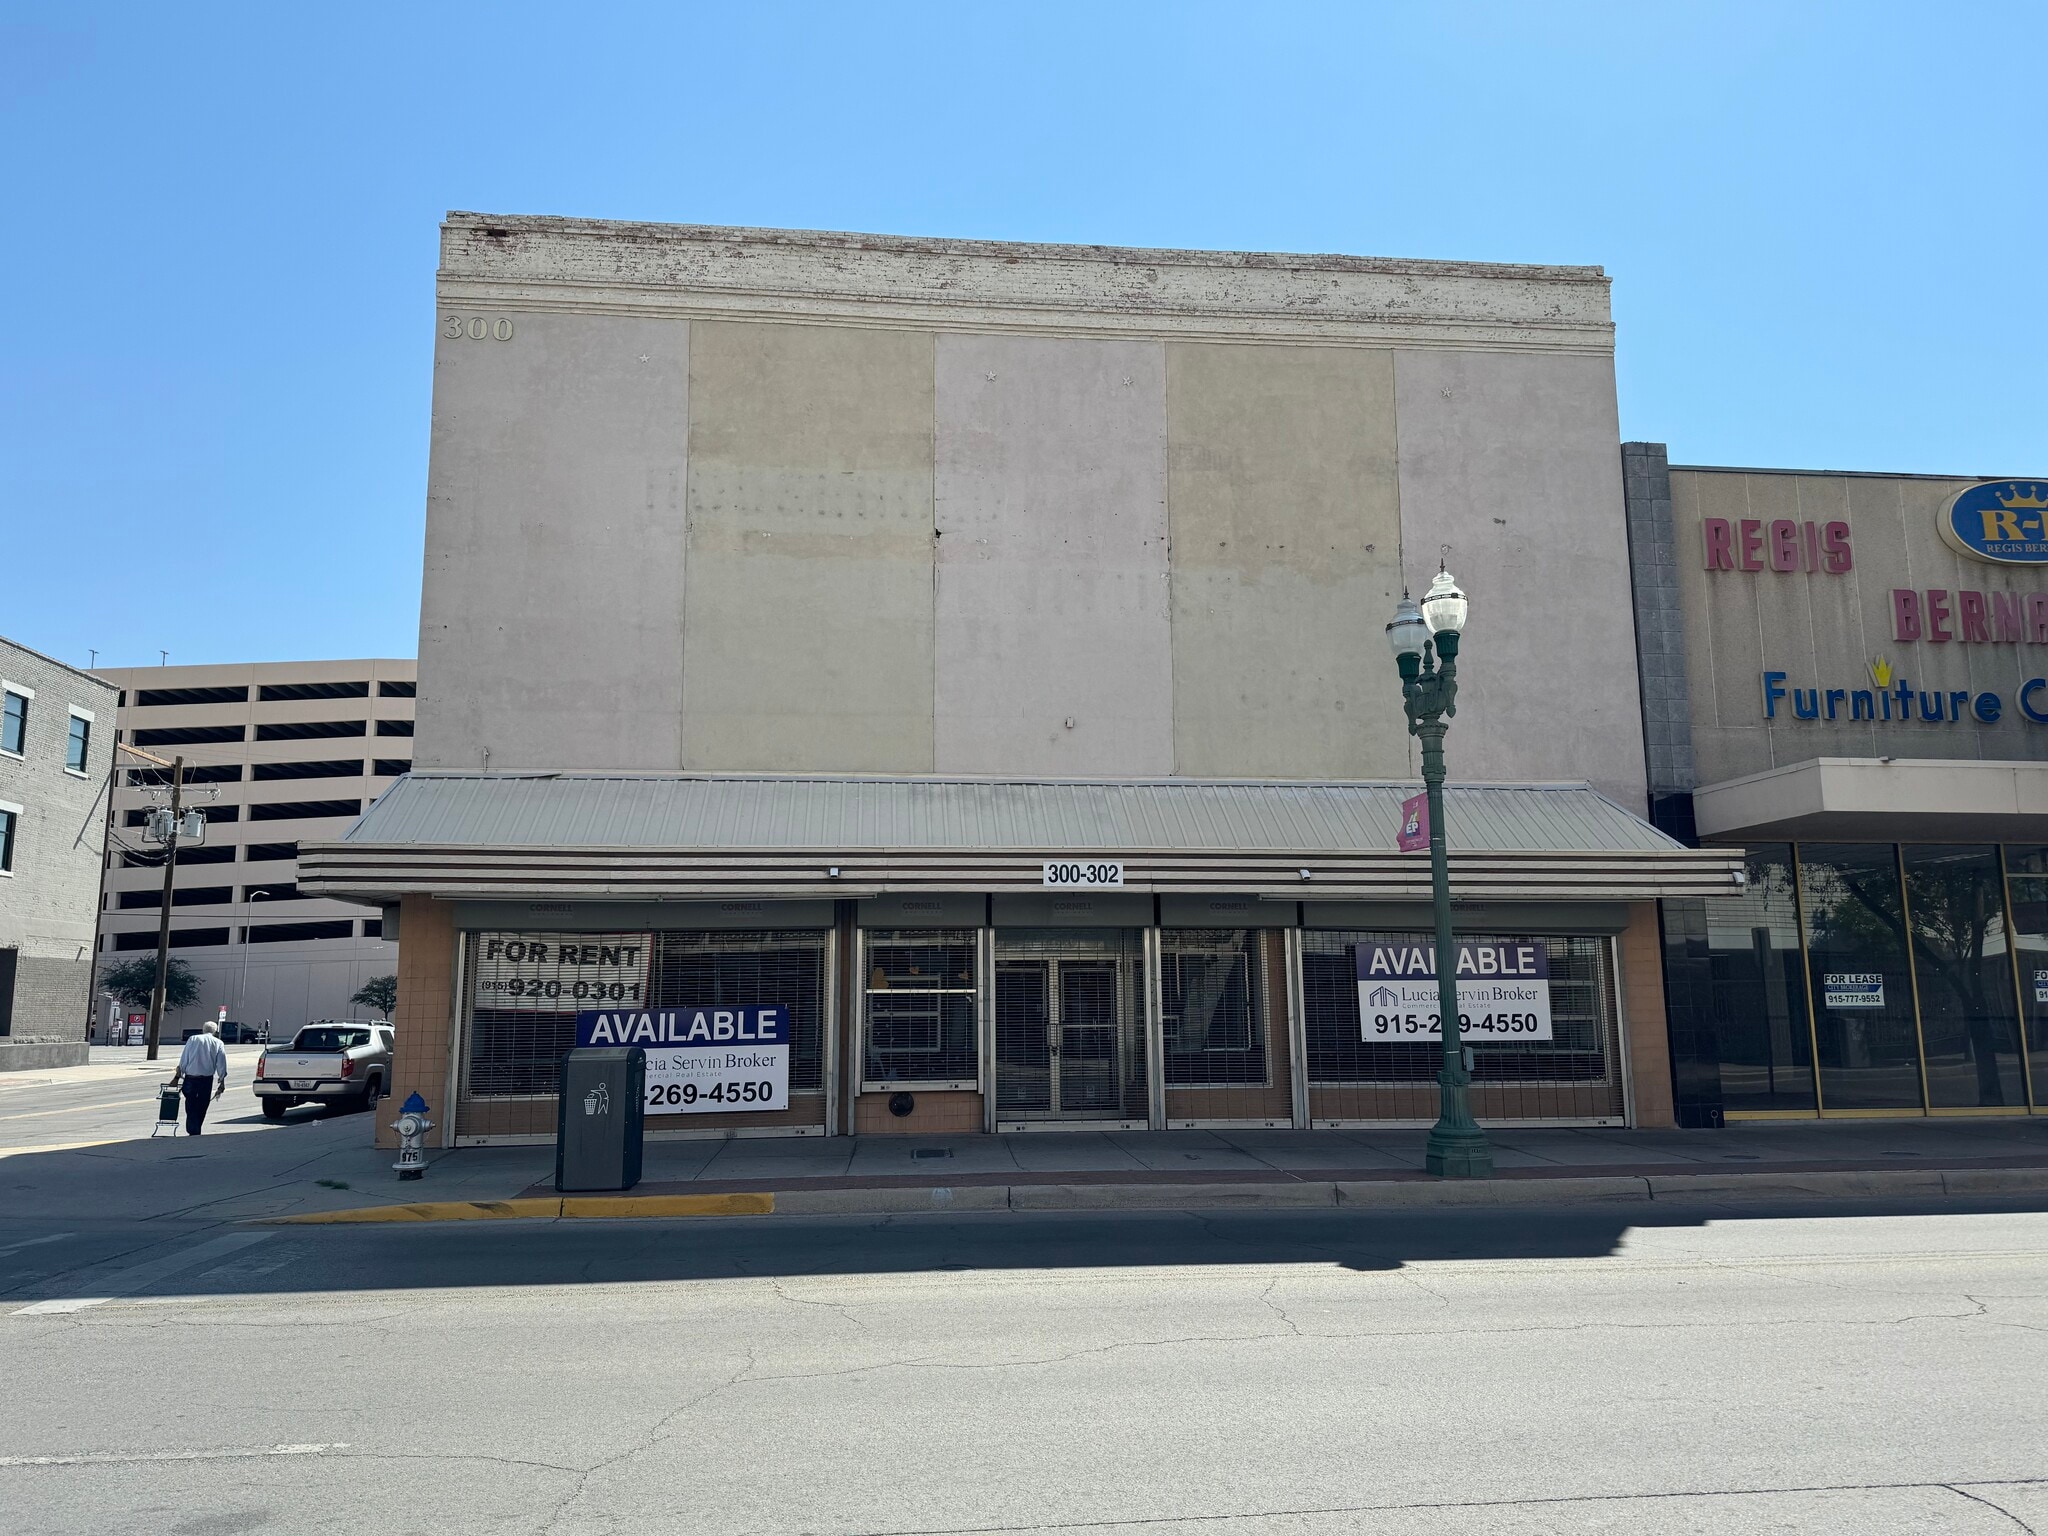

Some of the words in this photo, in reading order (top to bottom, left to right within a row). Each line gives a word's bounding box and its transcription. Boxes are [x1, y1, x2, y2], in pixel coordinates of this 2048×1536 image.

[443, 315, 514, 341] 300
[1977, 510, 2048, 541] R-
[1704, 518, 1853, 574] REGIS
[1986, 543, 2023, 553] REGIS
[1761, 671, 2002, 724] Furniture
[1406, 821, 1419, 834] EP
[1048, 864, 1119, 884] 300-302
[529, 904, 573, 912] CORNELL
[721, 903, 762, 911] CORNELL
[902, 902, 942, 910] CORNELL
[1054, 902, 1093, 911] CORNELL
[1209, 902, 1249, 910] CORNELL
[486, 939, 549, 963] FOR
[559, 944, 642, 967] RENT
[1369, 947, 1537, 975] AVAIABLE
[1824, 975, 1846, 984] FOR
[1848, 975, 1882, 984] LEASE
[1456, 989, 1490, 1001] ervin
[1492, 986, 1538, 1001] Broker
[1828, 994, 1881, 1003] 915-777-9552
[589, 1010, 777, 1044] AVAILABLE
[1374, 1013, 1539, 1034] 915-29-4550
[645, 1058, 667, 1071] cia
[672, 1054, 721, 1070] Servin
[725, 1053, 777, 1068] Broker
[696, 1070, 722, 1078] Estate
[402, 1152, 418, 1162] 975
